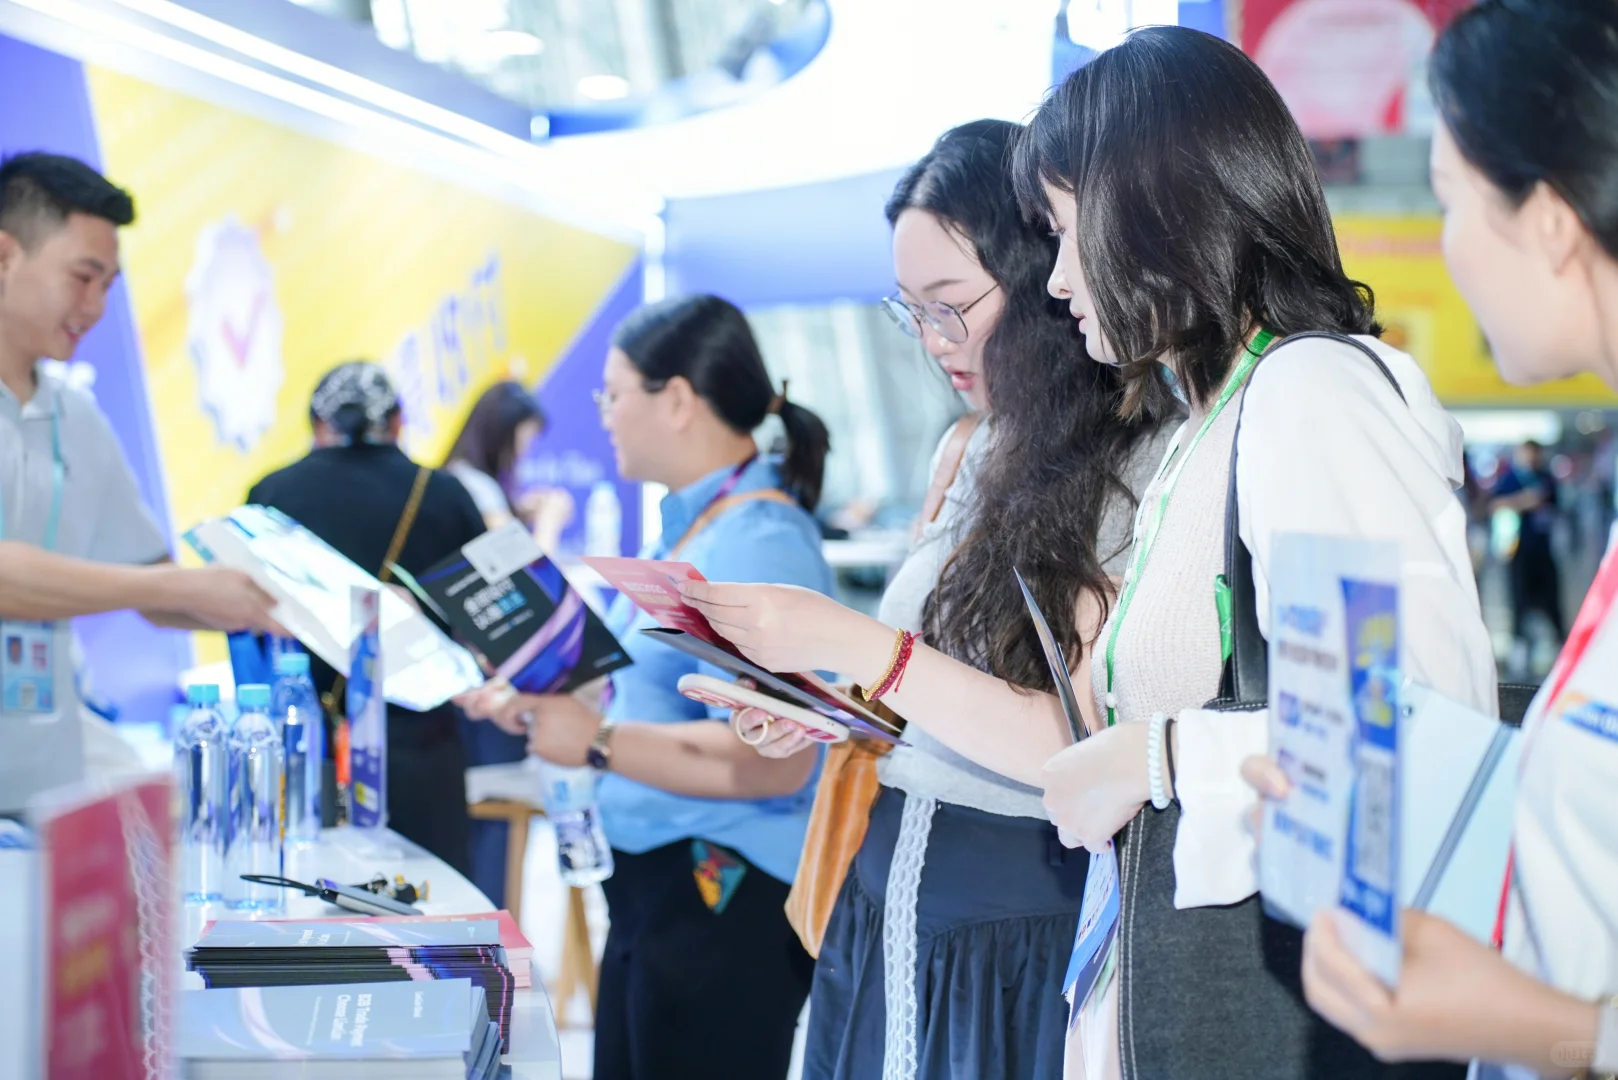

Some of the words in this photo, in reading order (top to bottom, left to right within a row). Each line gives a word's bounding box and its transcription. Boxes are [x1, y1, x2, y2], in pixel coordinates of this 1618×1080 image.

[335, 994, 351, 1018] Choose
[357, 993, 372, 1007] B2B
[354, 1007, 370, 1023] Trade
